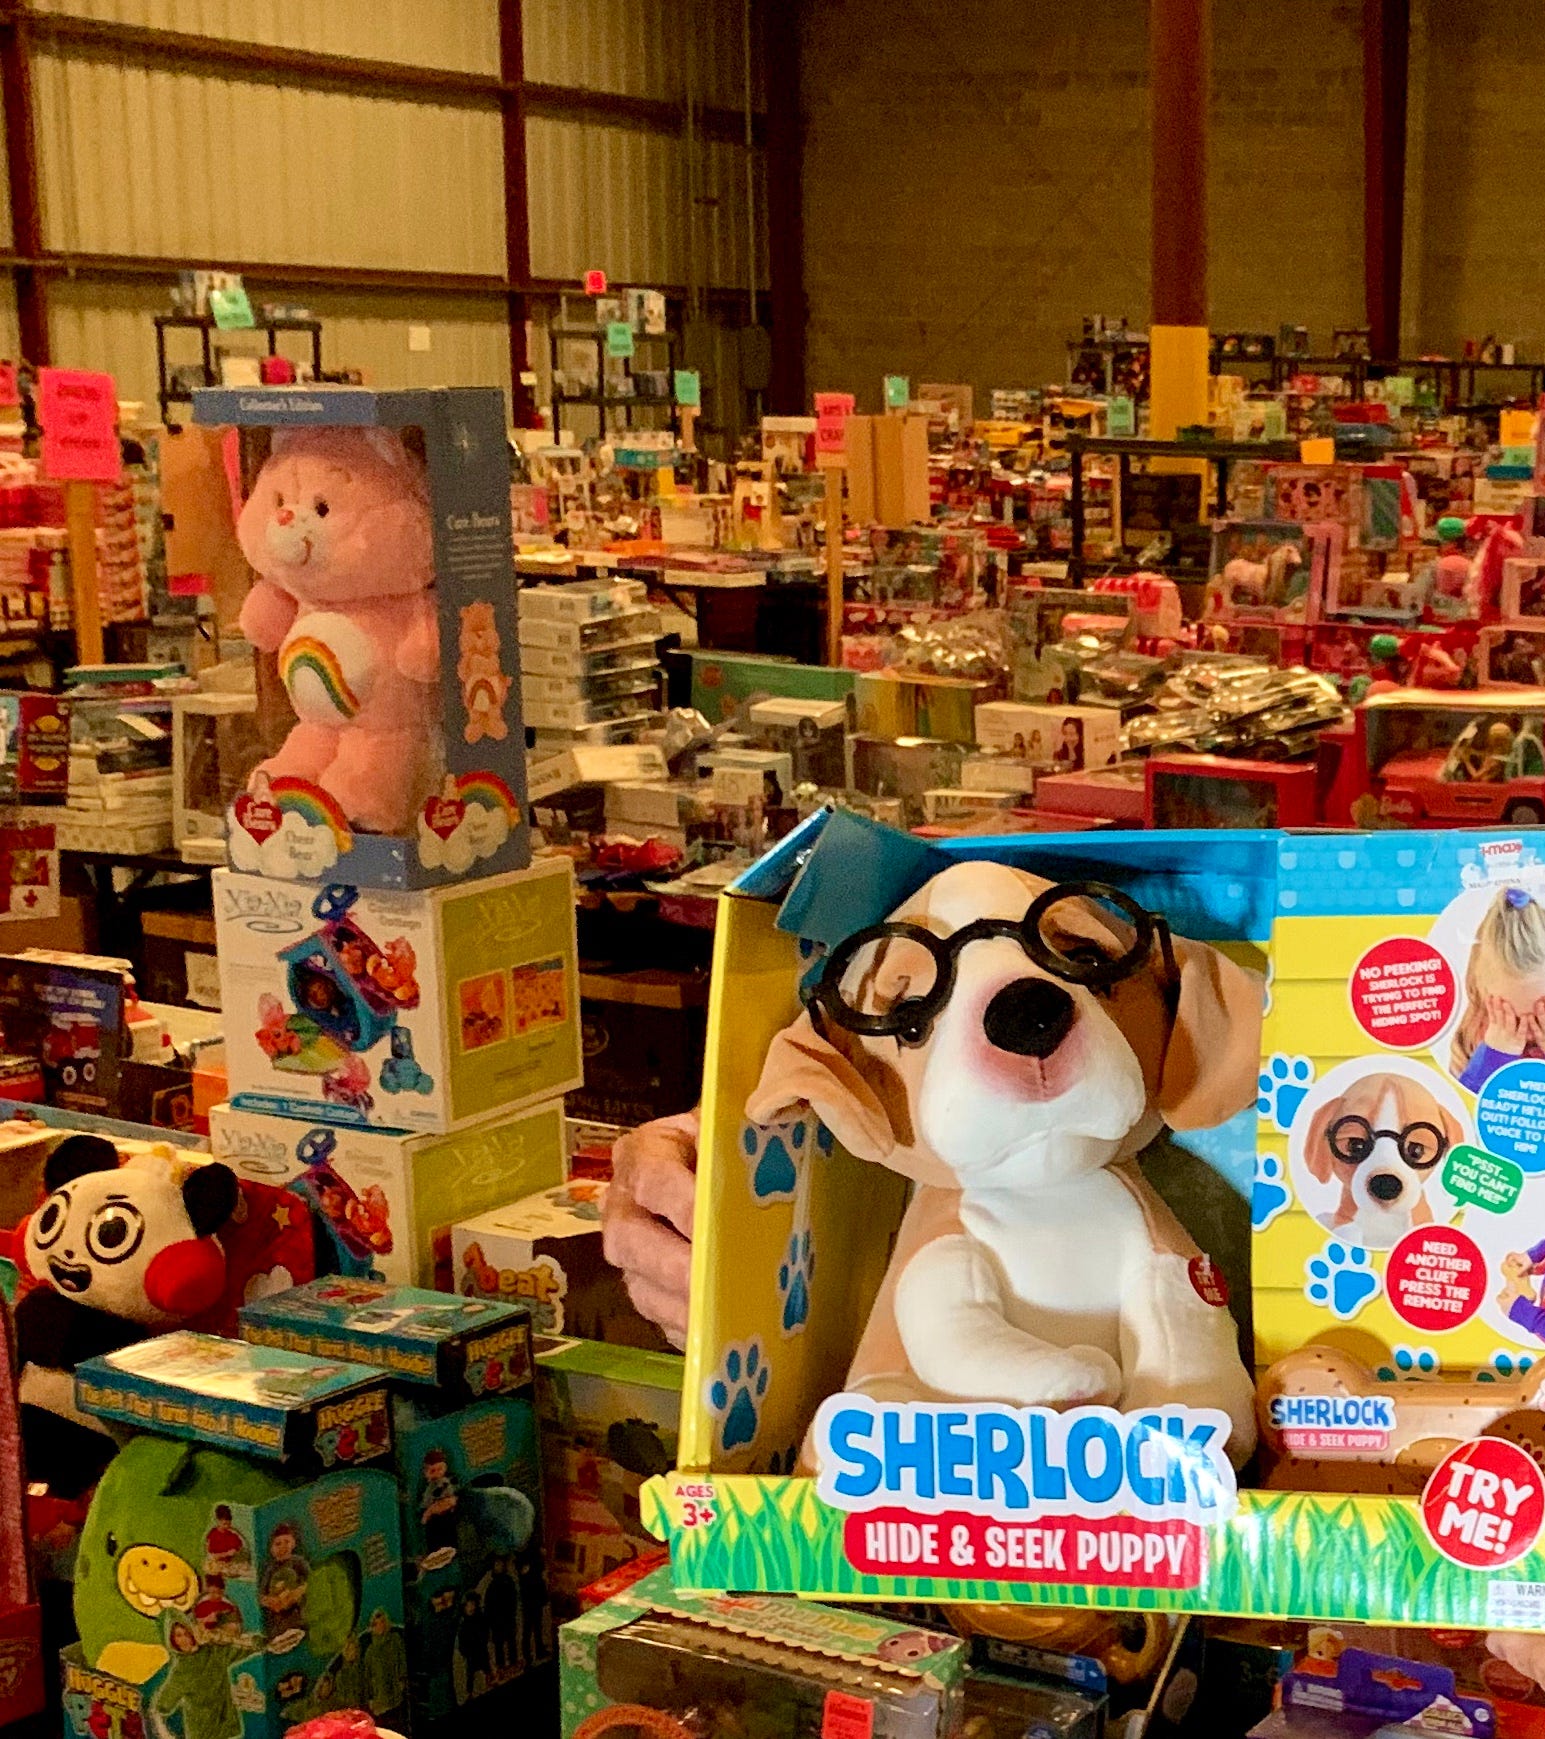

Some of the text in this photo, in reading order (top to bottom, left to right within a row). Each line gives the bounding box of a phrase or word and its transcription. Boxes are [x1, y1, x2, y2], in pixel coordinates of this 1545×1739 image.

[1360, 958, 1442, 980] NO PEEKING!
[1369, 973, 1436, 991] SHERLOCK IS
[1361, 985, 1446, 1004] TRYING TO FIND
[1372, 998, 1438, 1015] THE PERFECT
[1371, 1010, 1441, 1028] HIDING SPOT!
[1481, 1098, 1519, 1113] READY
[1481, 1111, 1509, 1124] OUT!
[1486, 1124, 1521, 1139] VOICE
[1525, 1130, 1541, 1142] TO
[1514, 1141, 1538, 1153] HIM!
[1449, 1174, 1477, 1193] FIND
[1452, 1160, 1518, 1197] YOU CAN'T
[1422, 1240, 1458, 1256] NEED
[1404, 1253, 1472, 1272] ANOTHER
[1415, 1267, 1458, 1284] CLUE?
[1399, 1279, 1471, 1300] PRESS THE
[1402, 1294, 1463, 1313] REMOTE!
[317, 1389, 388, 1431] HUGGLE
[1270, 1398, 1389, 1427] SHERLOCK
[1308, 1433, 1317, 1446] &
[1320, 1434, 1345, 1447] SEEK
[1347, 1434, 1381, 1448] PUPPY
[829, 1409, 1219, 1508] SHERLOCK
[675, 1485, 714, 1498] AGES
[1447, 1461, 1534, 1516] TRY
[683, 1502, 714, 1526] 3+
[1437, 1501, 1513, 1554] ME!
[865, 1521, 1187, 1575] HIDE & SEEK PUPPY
[66, 1664, 142, 1711] HUGGLE
